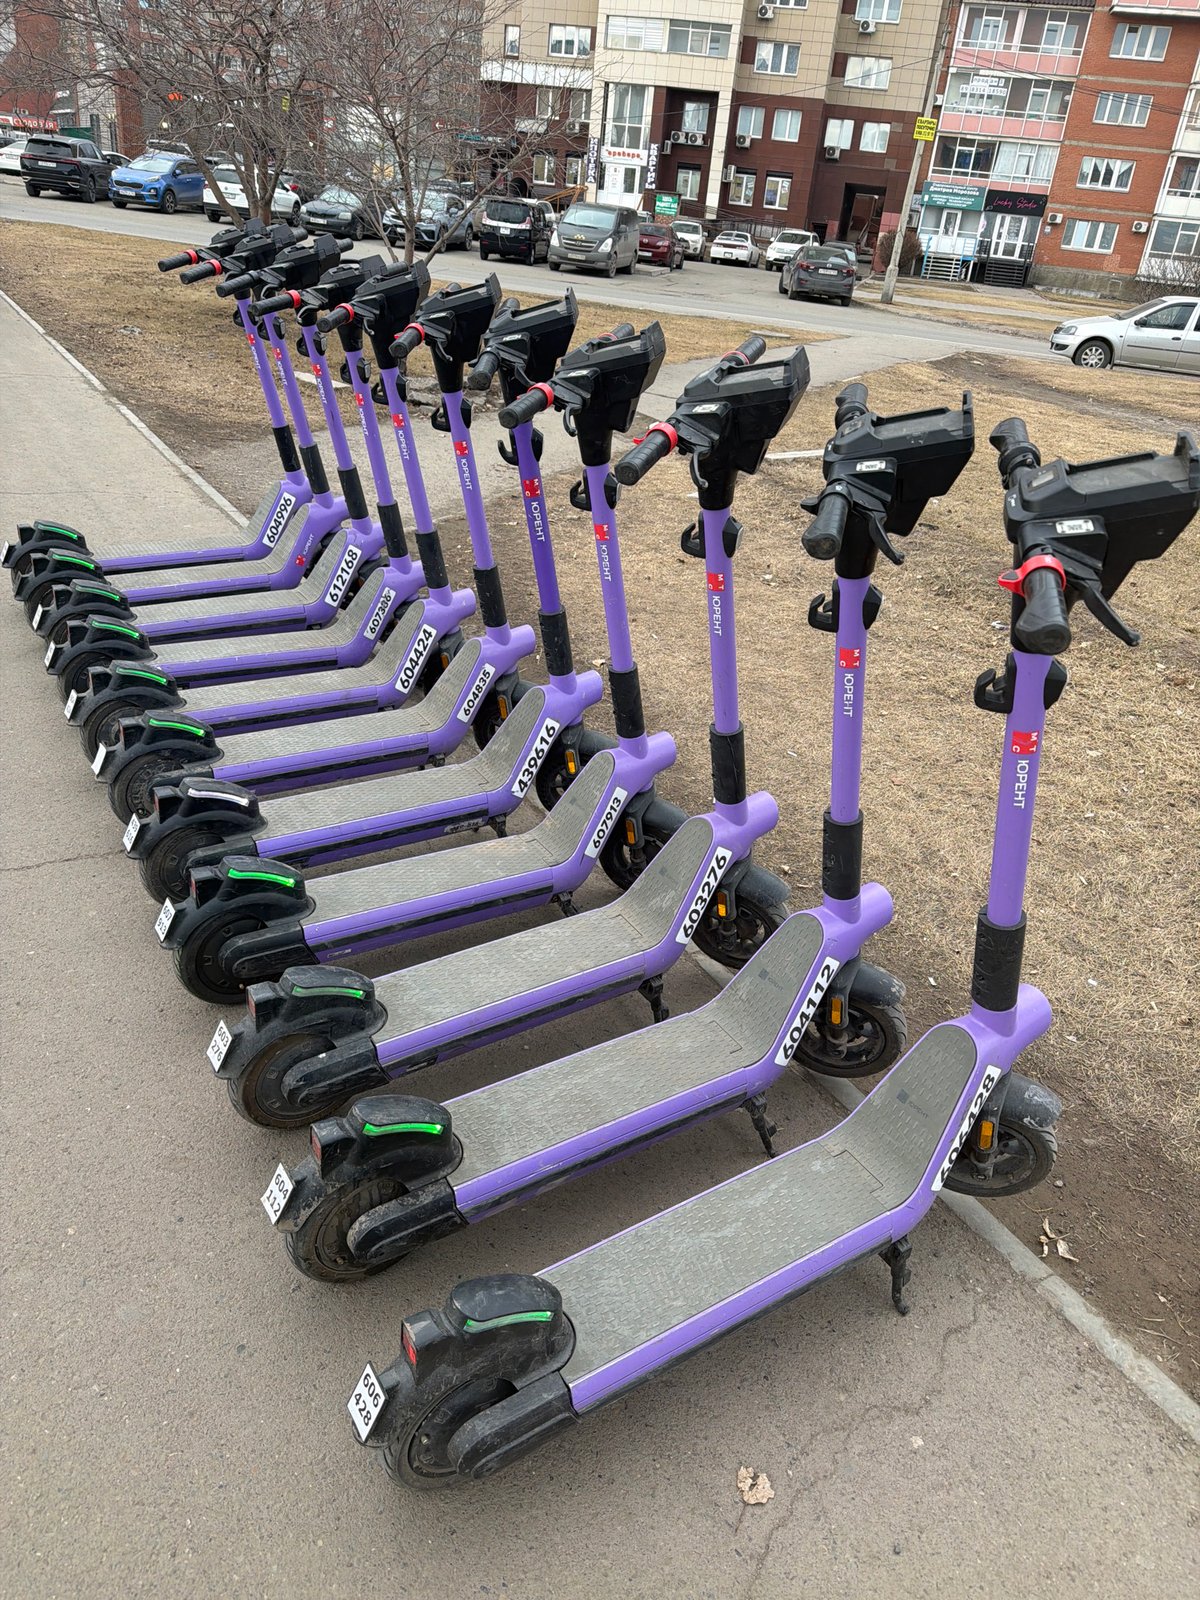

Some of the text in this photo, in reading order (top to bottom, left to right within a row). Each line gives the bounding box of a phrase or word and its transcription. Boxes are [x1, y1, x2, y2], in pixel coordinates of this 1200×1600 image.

[587, 138, 599, 183] ИПОТЕКА
[645, 144, 659, 189] КВАРТИРЫ
[993, 197, 1013, 208] Lucky
[398, 430, 410, 460] ЮРЕНТ
[461, 459, 473, 490] ЮРЕНТ
[266, 496, 293, 544] 604996
[531, 501, 546, 542] ЮРЕНТ
[329, 549, 359, 603] 612168
[600, 545, 612, 582] ЮРЕНТ
[712, 595, 723, 637] ЮРЕНТ
[398, 628, 434, 690] 604424
[463, 669, 491, 717] 604835
[843, 673, 855, 718] ЮРЕНТ
[517, 724, 556, 794] 439616
[1013, 760, 1029, 809] ЮРЕНТ
[592, 796, 622, 849] 607913
[683, 854, 727, 939] 603276
[783, 963, 835, 1060] 604112
[211, 1039, 223, 1061] 276
[217, 1026, 230, 1047] 603
[939, 1073, 997, 1184] 606428
[266, 1189, 281, 1218] 112
[274, 1172, 289, 1200] 604
[353, 1391, 372, 1427] 428
[362, 1372, 381, 1409] 606
